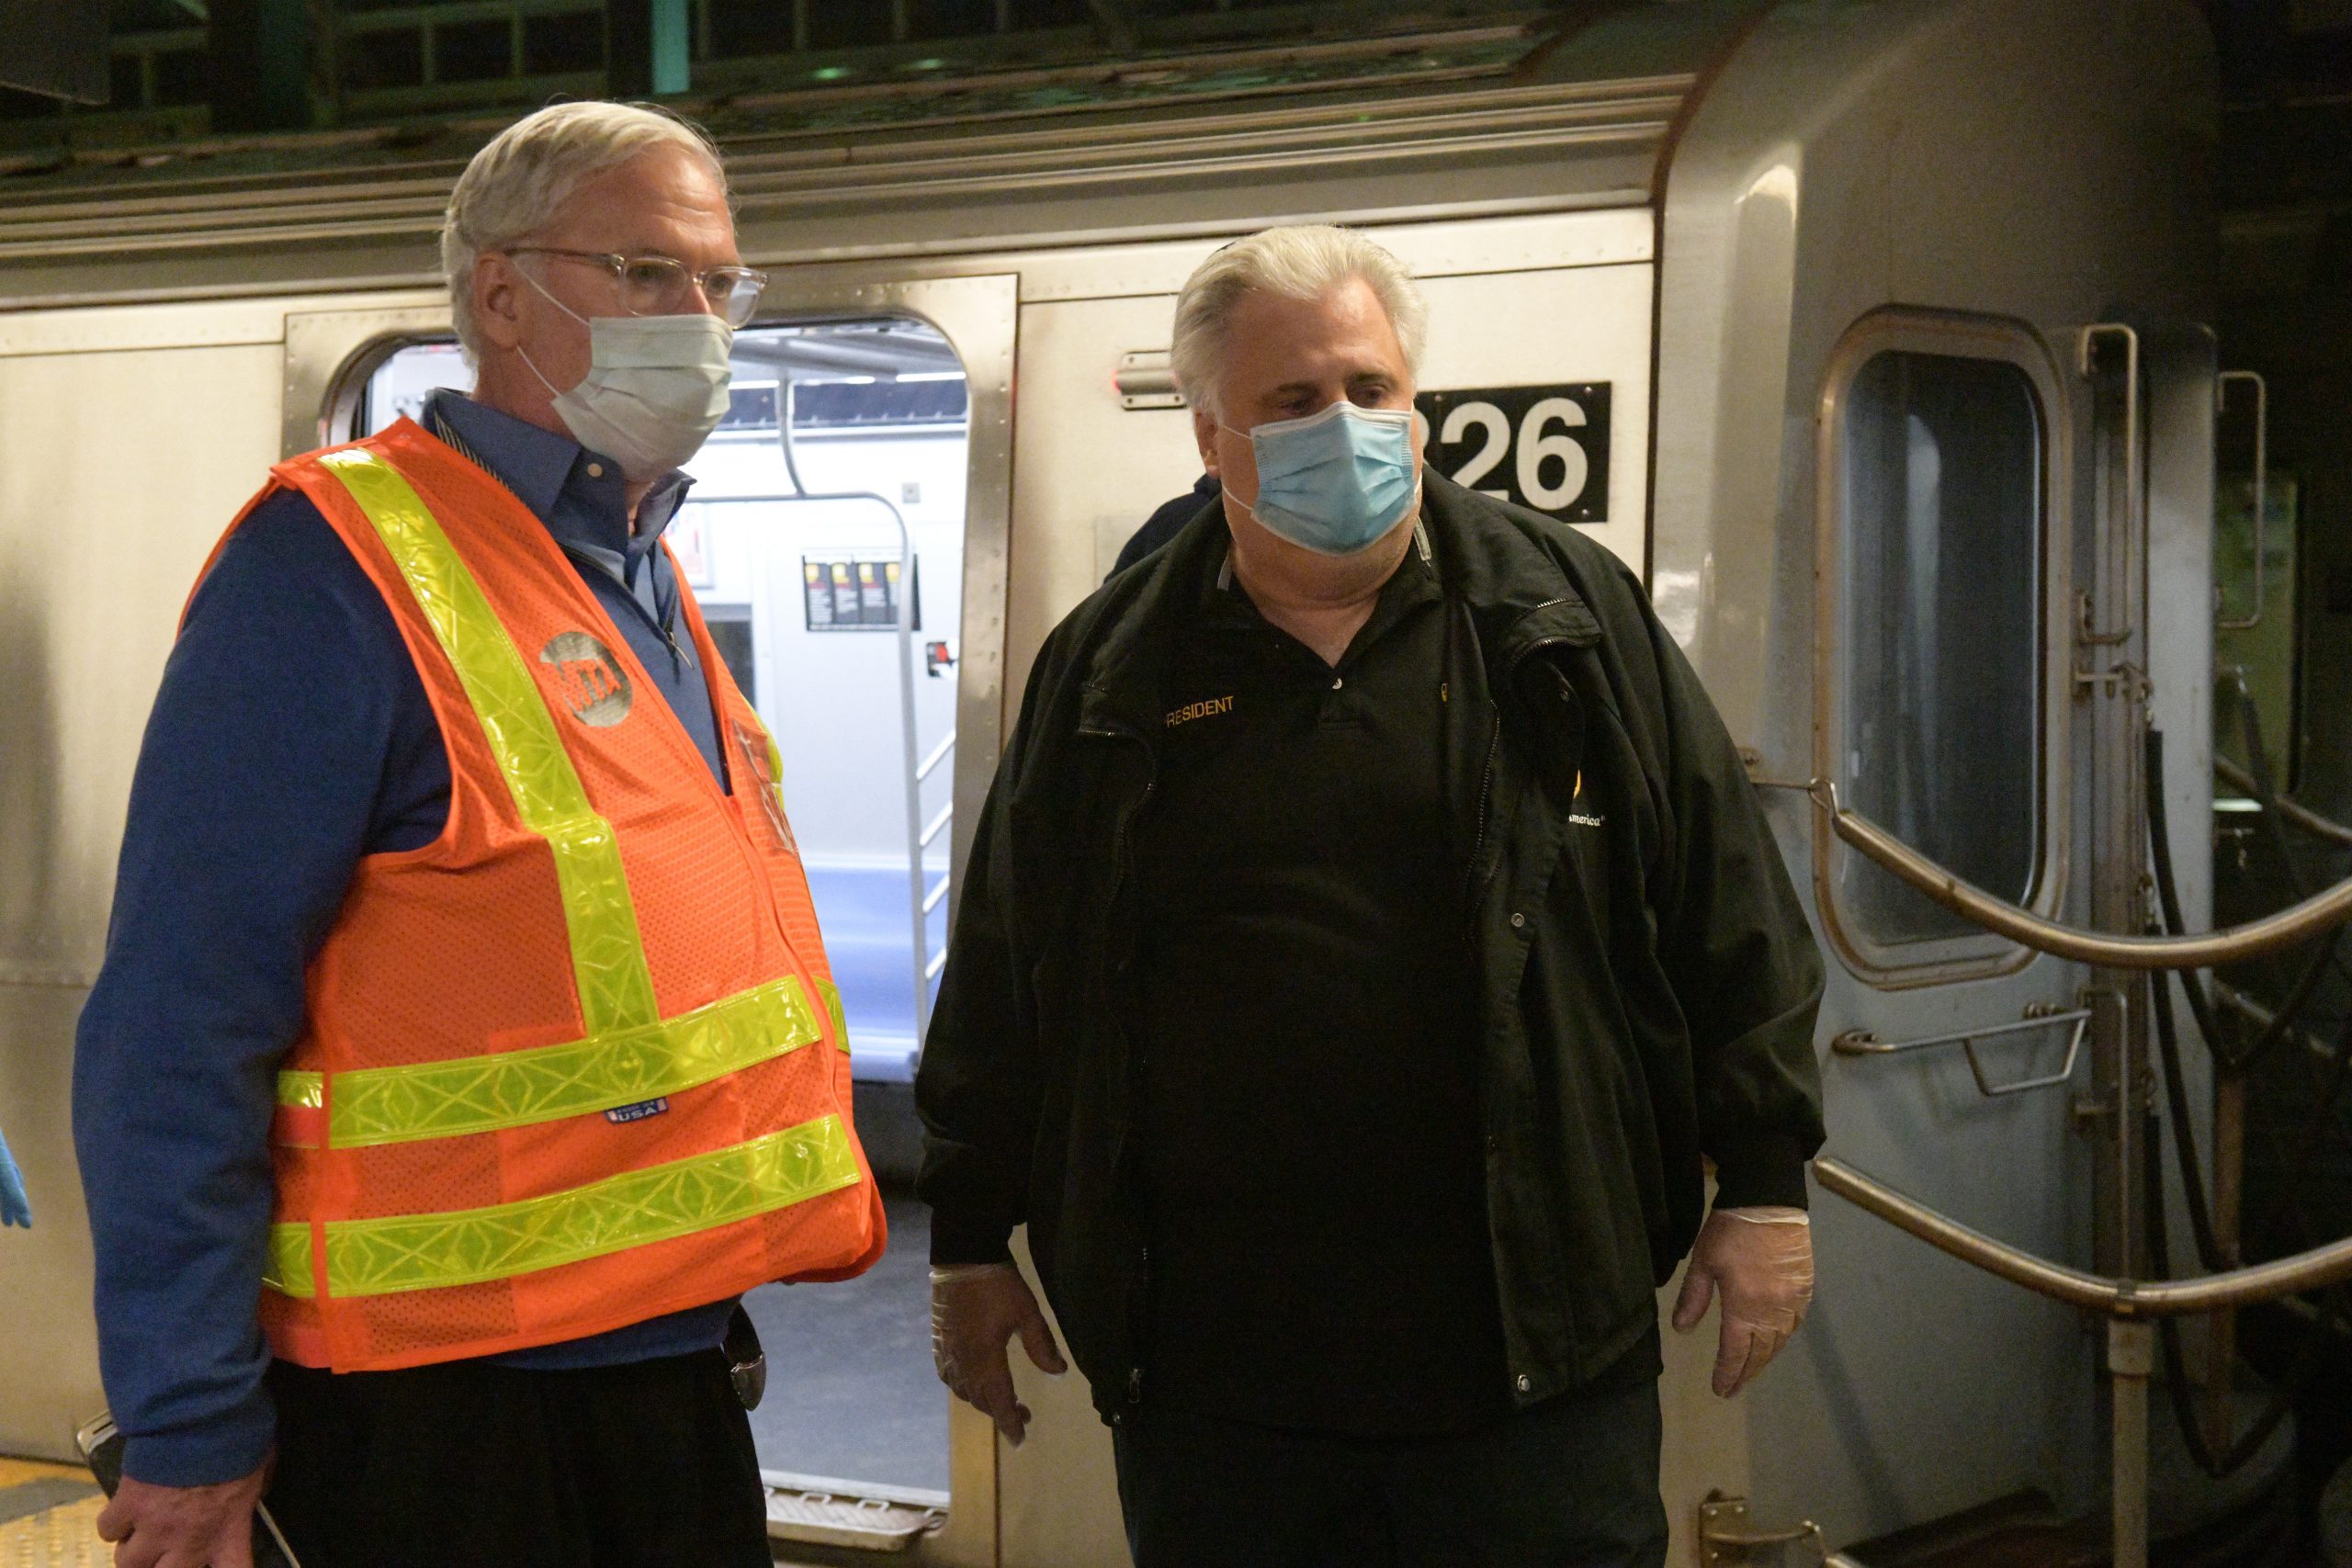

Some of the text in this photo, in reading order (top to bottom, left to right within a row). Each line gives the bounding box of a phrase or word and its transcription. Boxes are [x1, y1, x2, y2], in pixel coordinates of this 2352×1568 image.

[1414, 397, 1589, 511] 26
[1166, 695, 1235, 728] RESIDENT
[617, 1106, 658, 1122] USA
